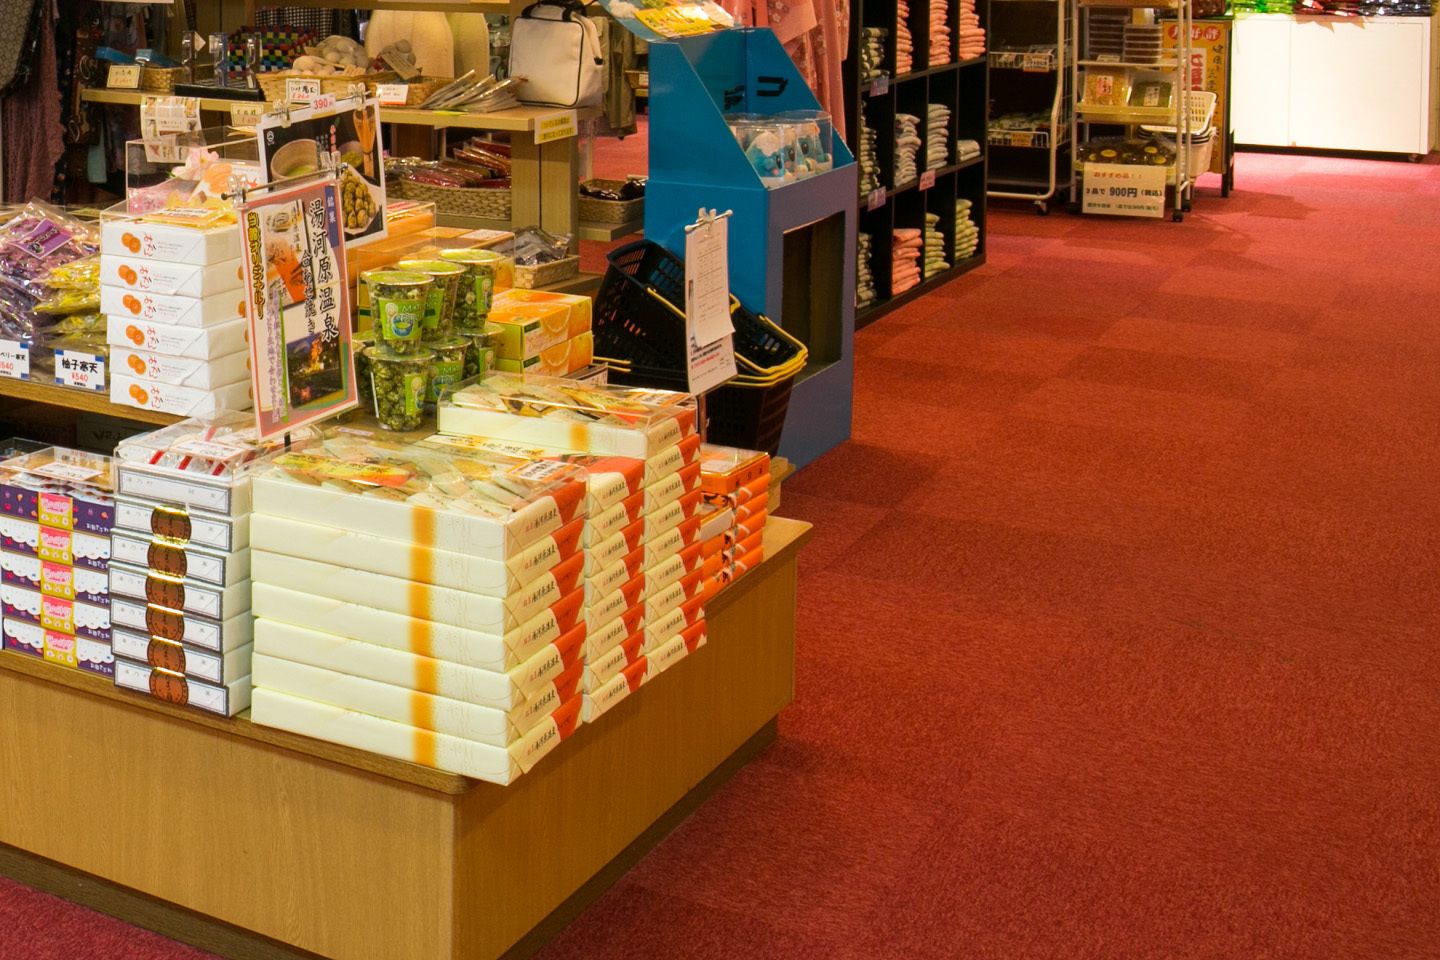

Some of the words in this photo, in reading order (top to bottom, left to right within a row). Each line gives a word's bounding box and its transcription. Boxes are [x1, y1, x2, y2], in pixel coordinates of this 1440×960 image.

[1109, 187, 1138, 198] 900円
[309, 198, 340, 344] 湯河原温泉
[61, 357, 99, 374] 柚子寒天
[71, 372, 89, 382] ¥540
